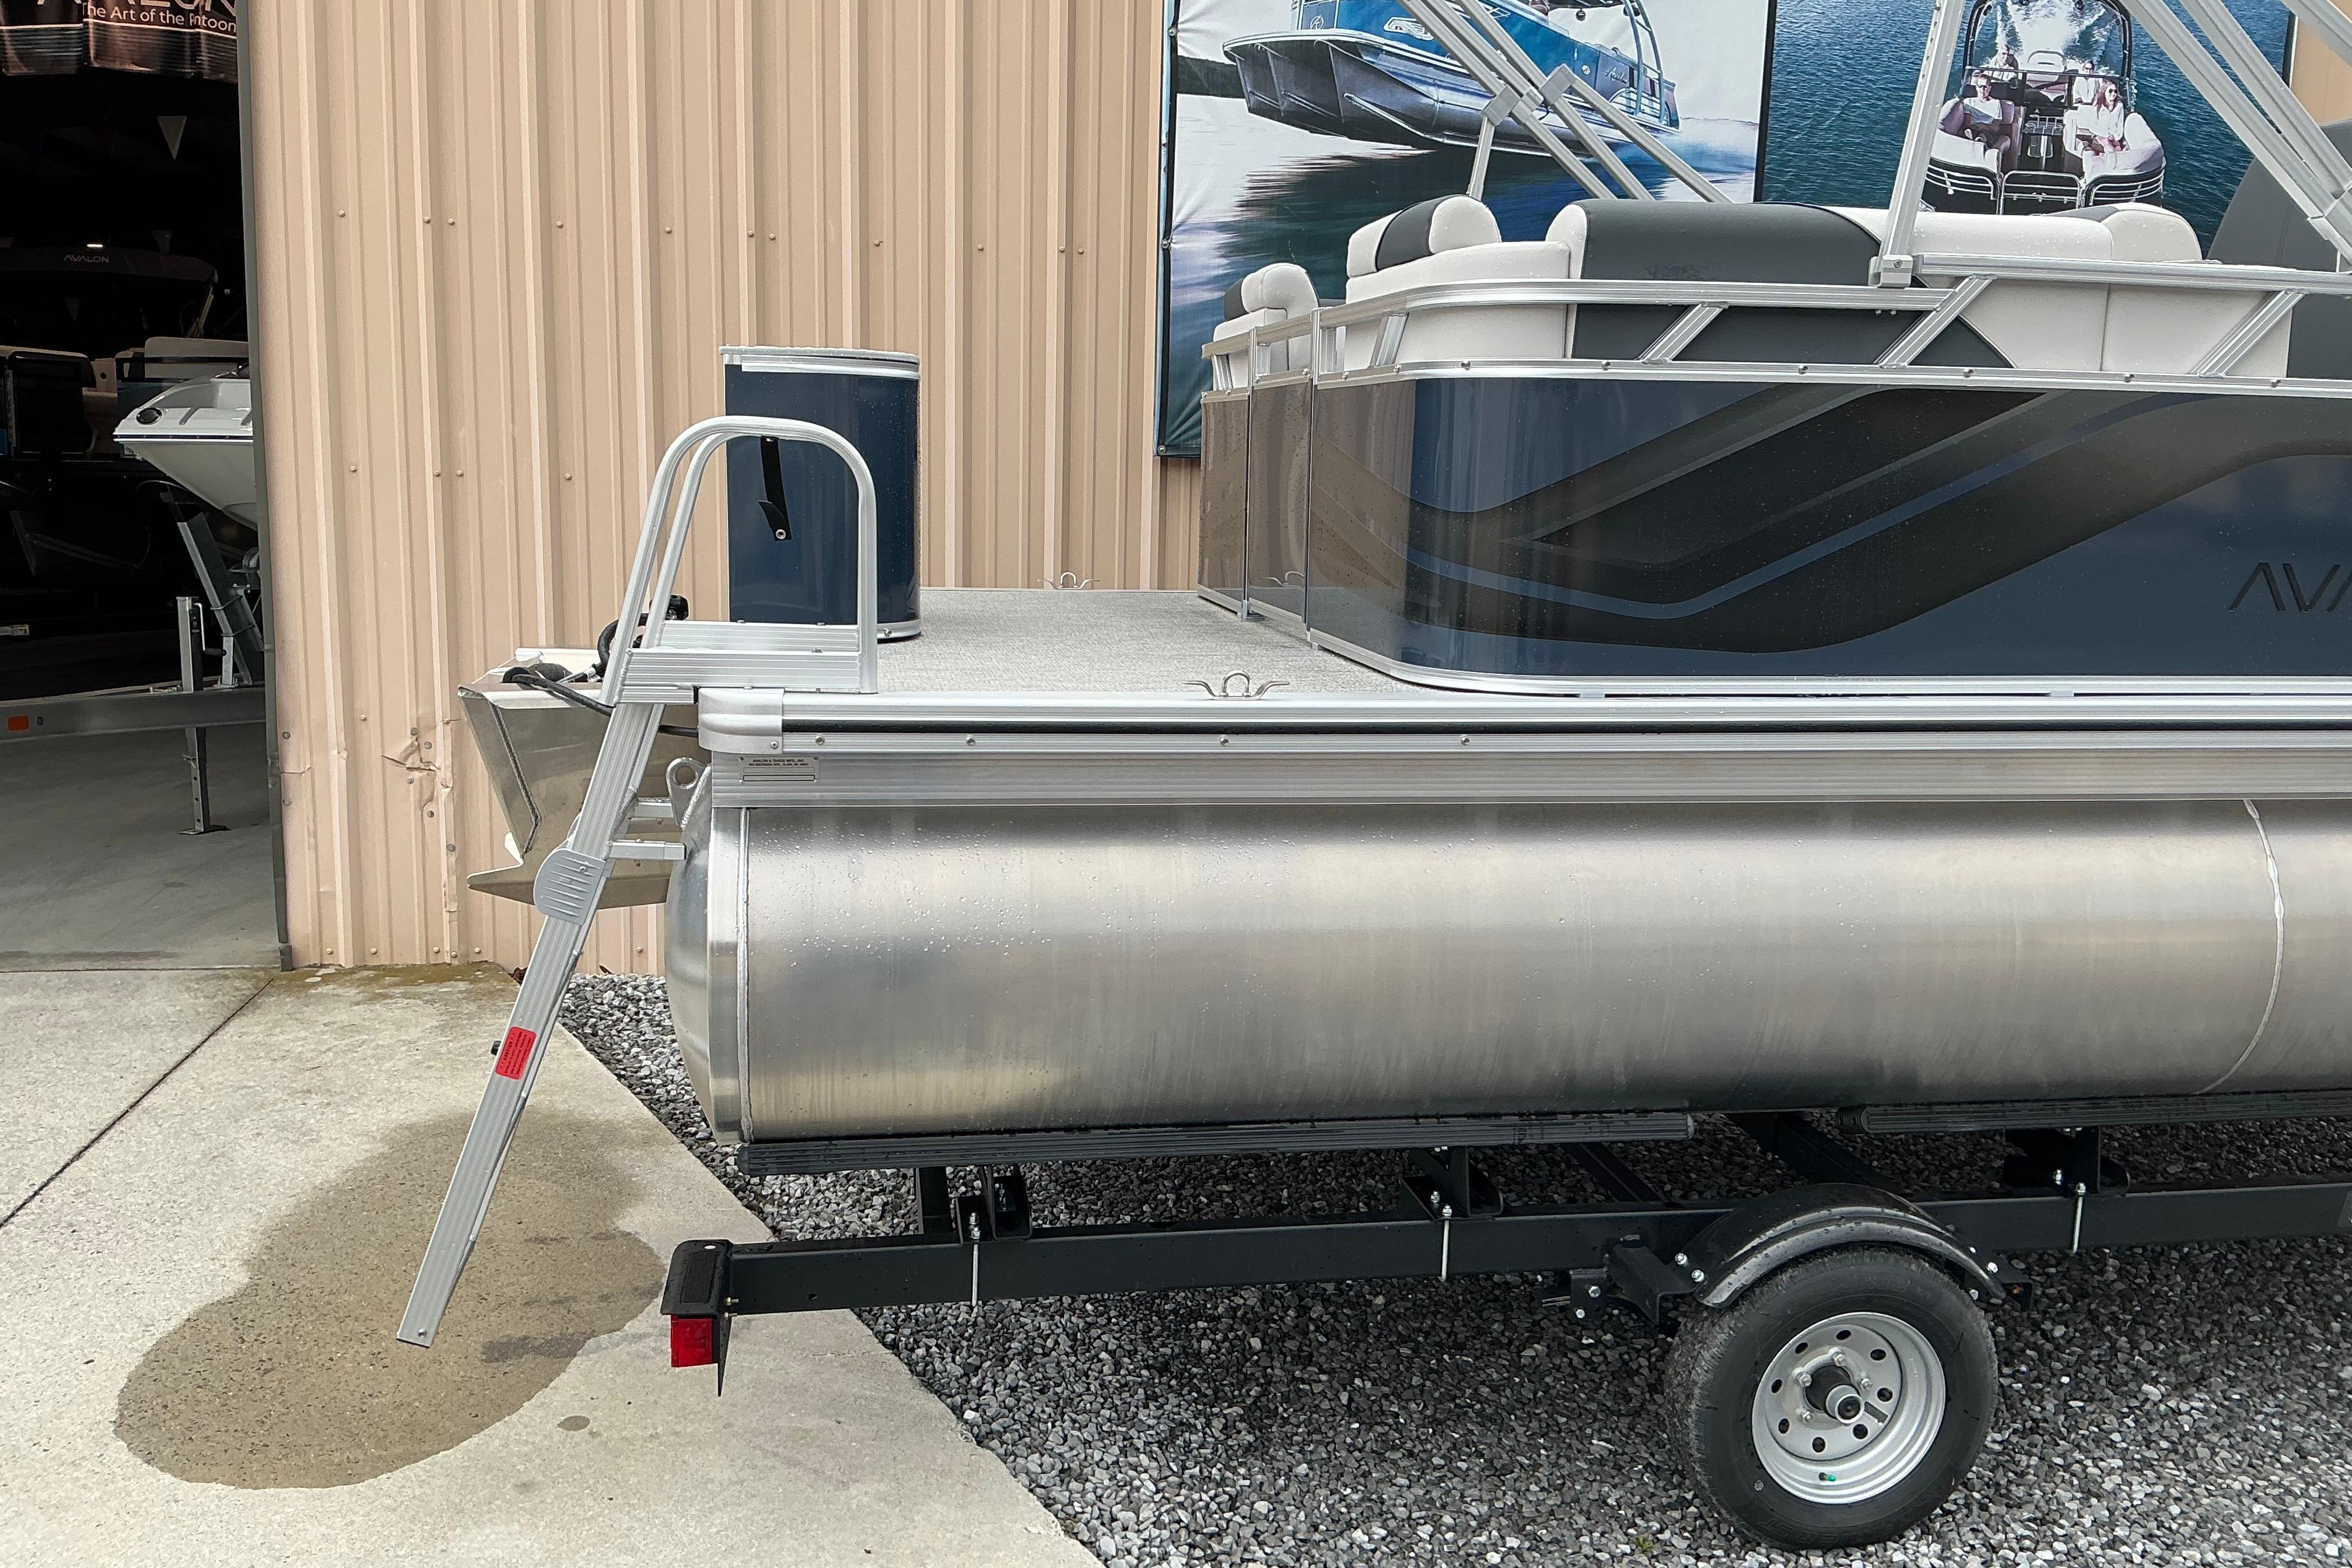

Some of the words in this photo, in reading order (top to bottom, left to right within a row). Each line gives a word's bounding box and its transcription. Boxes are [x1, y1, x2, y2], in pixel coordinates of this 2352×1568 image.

[111, 6, 136, 21] Art
[140, 9, 156, 22] of
[159, 10, 185, 25] the
[189, 13, 237, 33] Pntoon
[64, 254, 110, 262] AVALON
